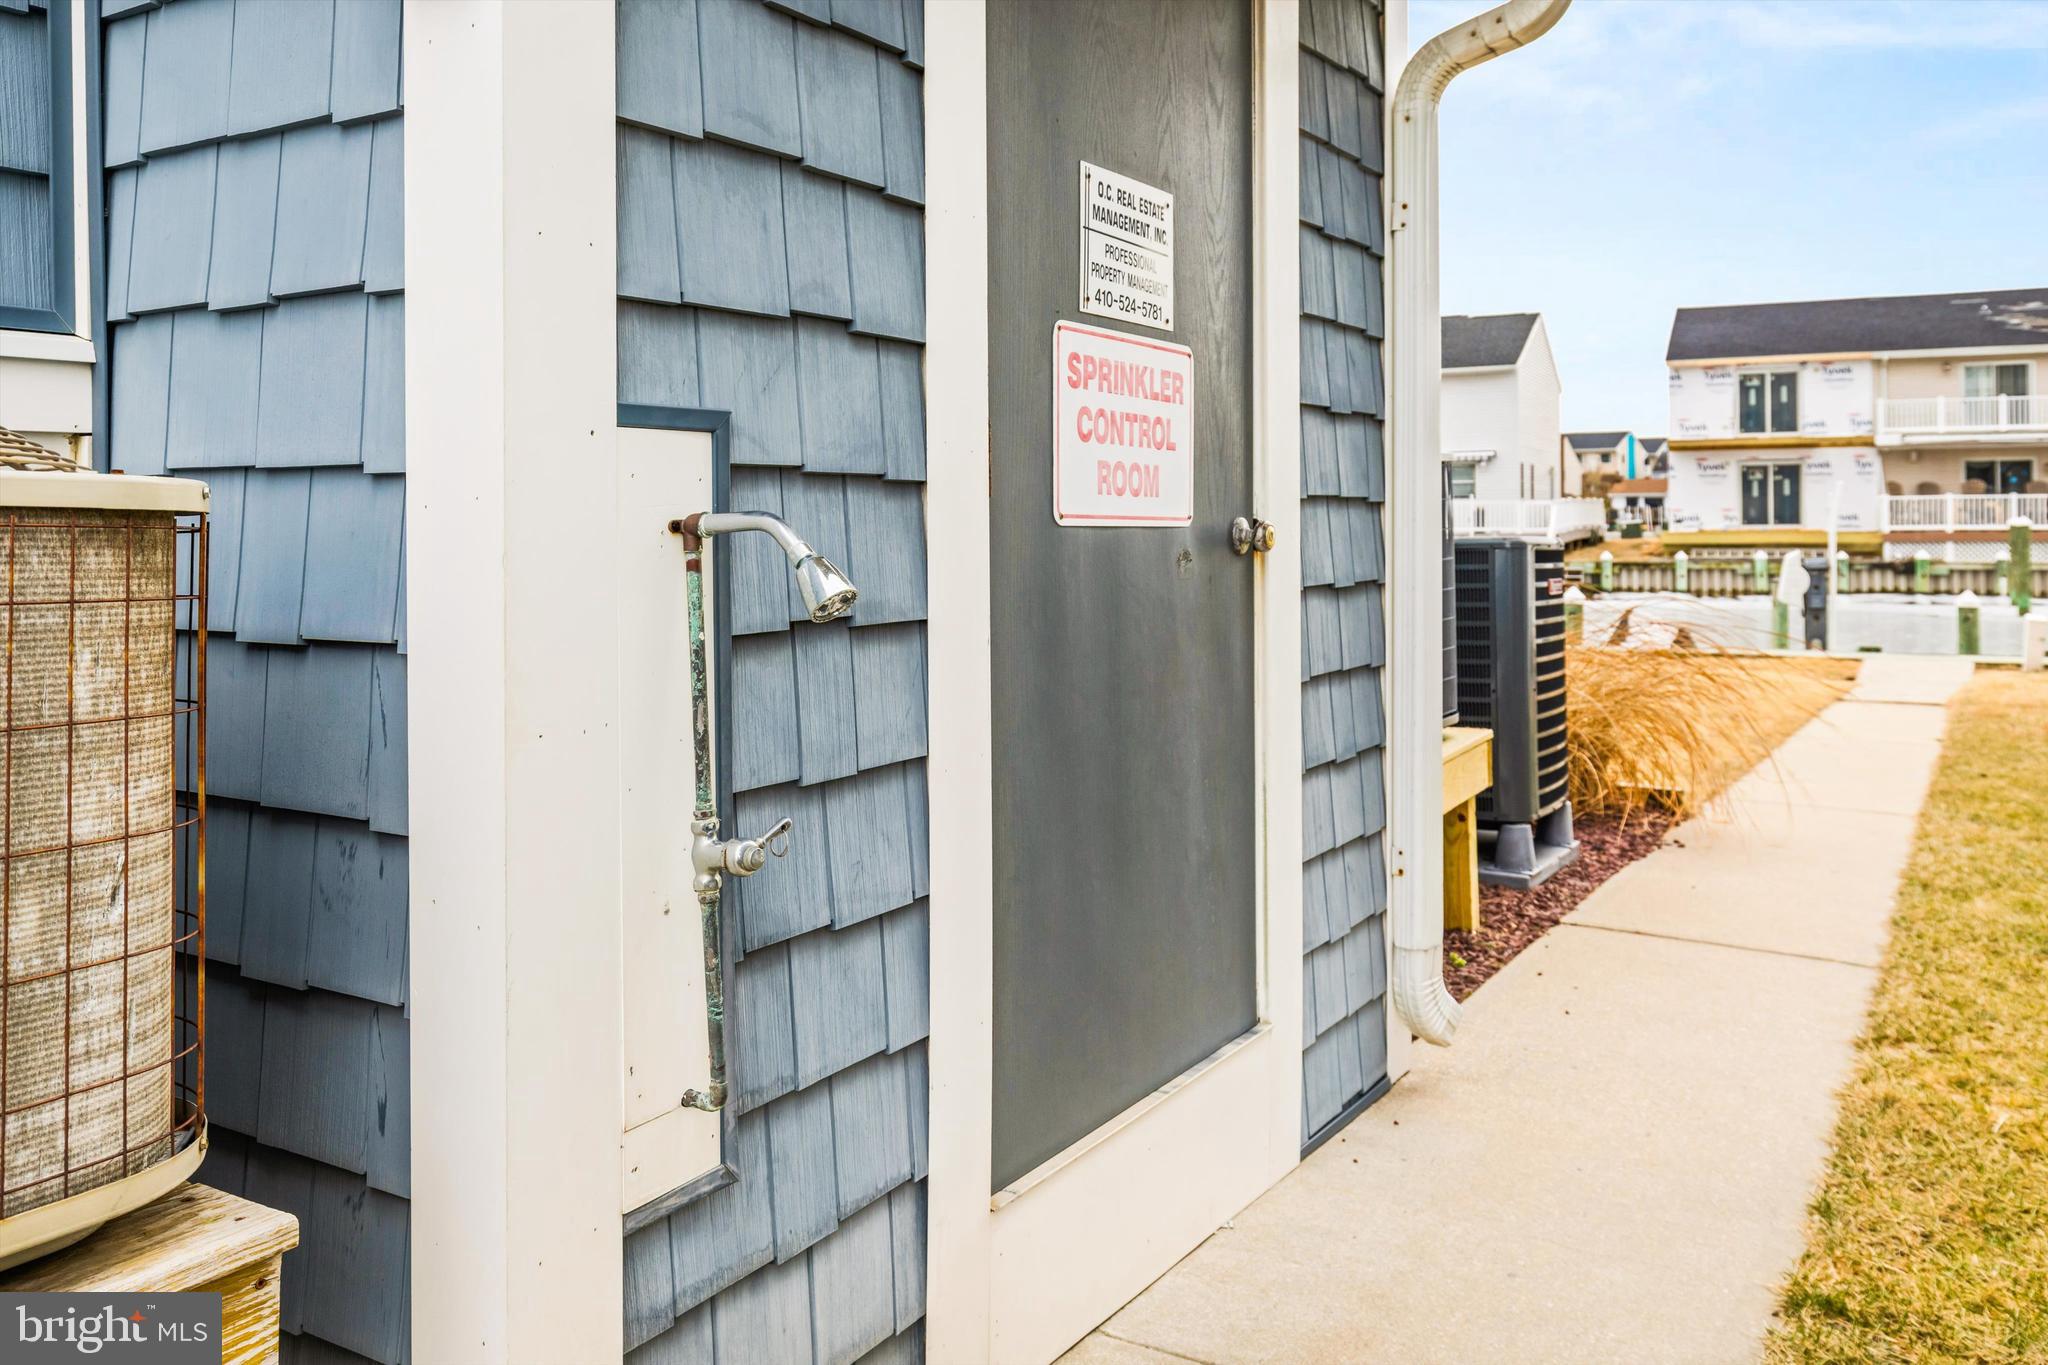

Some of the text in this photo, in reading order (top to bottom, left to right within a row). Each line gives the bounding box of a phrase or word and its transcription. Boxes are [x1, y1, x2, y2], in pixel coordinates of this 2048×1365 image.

[1097, 181, 1165, 222] O.C. REAL ESTATE
[1154, 226, 1169, 246] INC.
[1104, 243, 1157, 274] PROFESSIONAL
[1091, 261, 1169, 298] PROPERTY MANAGEMENT
[1094, 288, 1163, 322] 410-524-5781
[1066, 351, 1185, 406] SPRINKLER
[1076, 405, 1177, 452] CONTROL
[1096, 459, 1160, 498] ROOM
